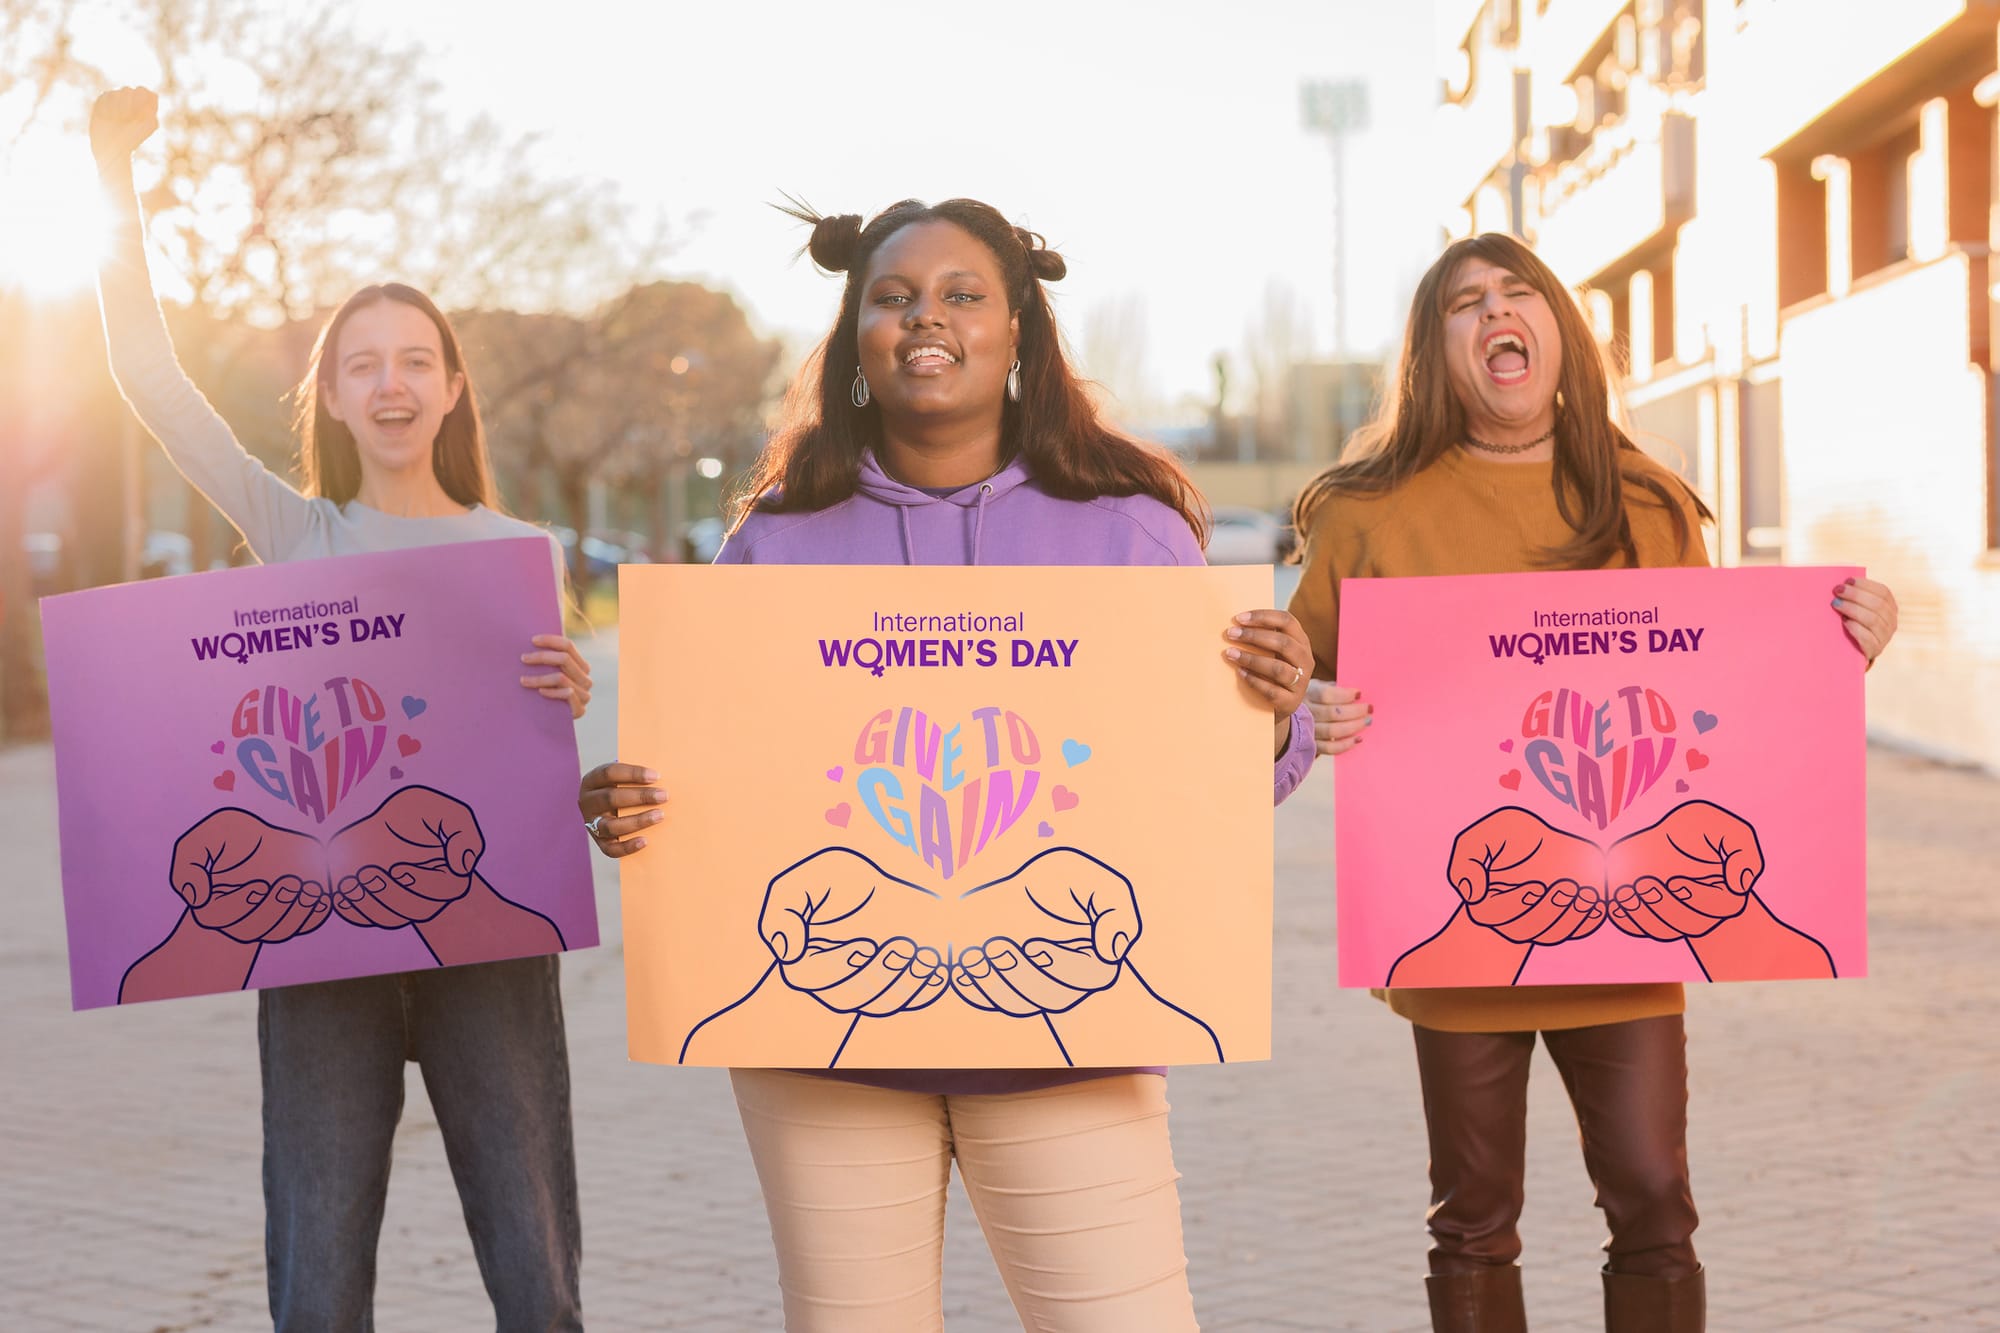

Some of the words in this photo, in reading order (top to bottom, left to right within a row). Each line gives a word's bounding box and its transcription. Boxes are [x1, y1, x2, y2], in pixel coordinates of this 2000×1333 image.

[191, 622, 340, 664] WOMEN'S
[350, 613, 405, 643] DAY
[233, 596, 359, 627] International
[873, 611, 1023, 632] International
[1533, 606, 1659, 627] International
[818, 638, 998, 678] WOMEN'S
[1011, 639, 1079, 667] DAY
[1488, 630, 1638, 665] WOMEN'S
[1648, 628, 1705, 653] DAY
[231, 685, 325, 752] GIVE
[324, 676, 386, 728] TO
[1521, 687, 1614, 758] GIVE
[1617, 685, 1677, 737] TO
[236, 725, 387, 824] GAIN
[854, 706, 965, 792] GIVE
[971, 706, 1041, 768] TO
[1524, 736, 1677, 831] GAIN
[856, 767, 1041, 880] GAIN
